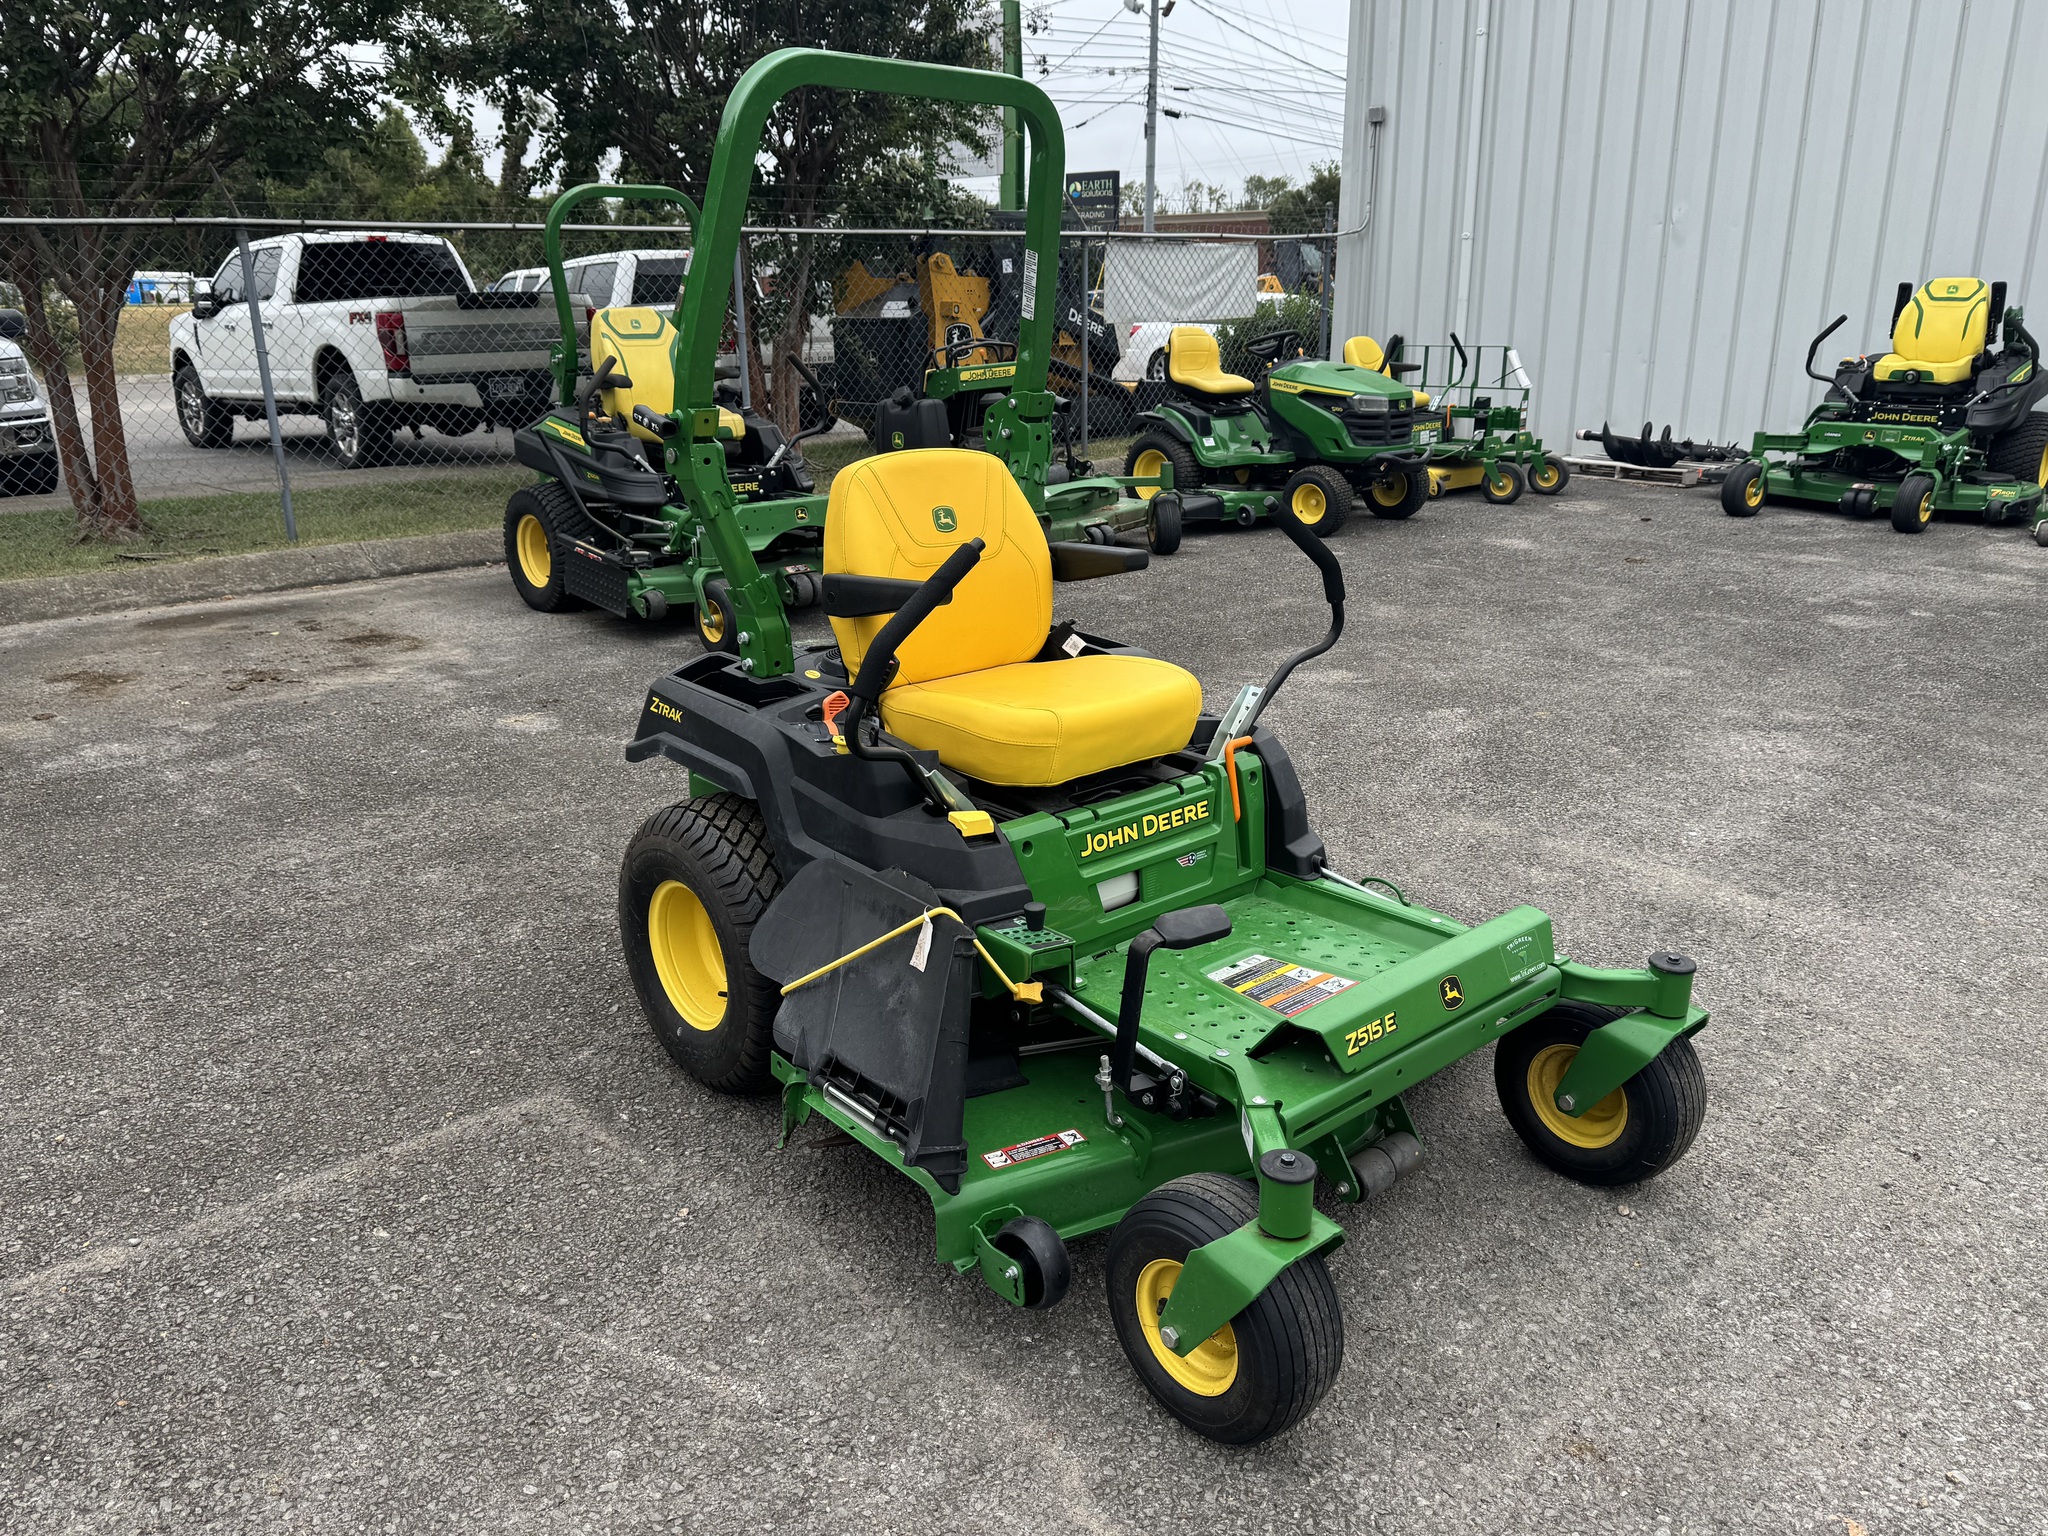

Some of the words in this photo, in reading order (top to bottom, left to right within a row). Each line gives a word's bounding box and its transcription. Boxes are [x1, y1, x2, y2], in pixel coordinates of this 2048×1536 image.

[1082, 179, 1113, 190] EARTH
[1078, 211, 1105, 219] RADING
[968, 371, 987, 380] JOHN
[988, 368, 1012, 378] DEERE
[1871, 412, 1900, 421] JOHN
[1902, 413, 1938, 423] DEERE
[1412, 424, 1425, 432] JOHN
[1426, 421, 1442, 430] DEERE
[731, 482, 759, 492] EERE
[650, 696, 683, 723] ZTRAK
[1081, 823, 1139, 857] JOHN
[1142, 800, 1210, 837] DEERE
[1345, 1018, 1383, 1056] Z515
[1384, 1012, 1397, 1033] E
